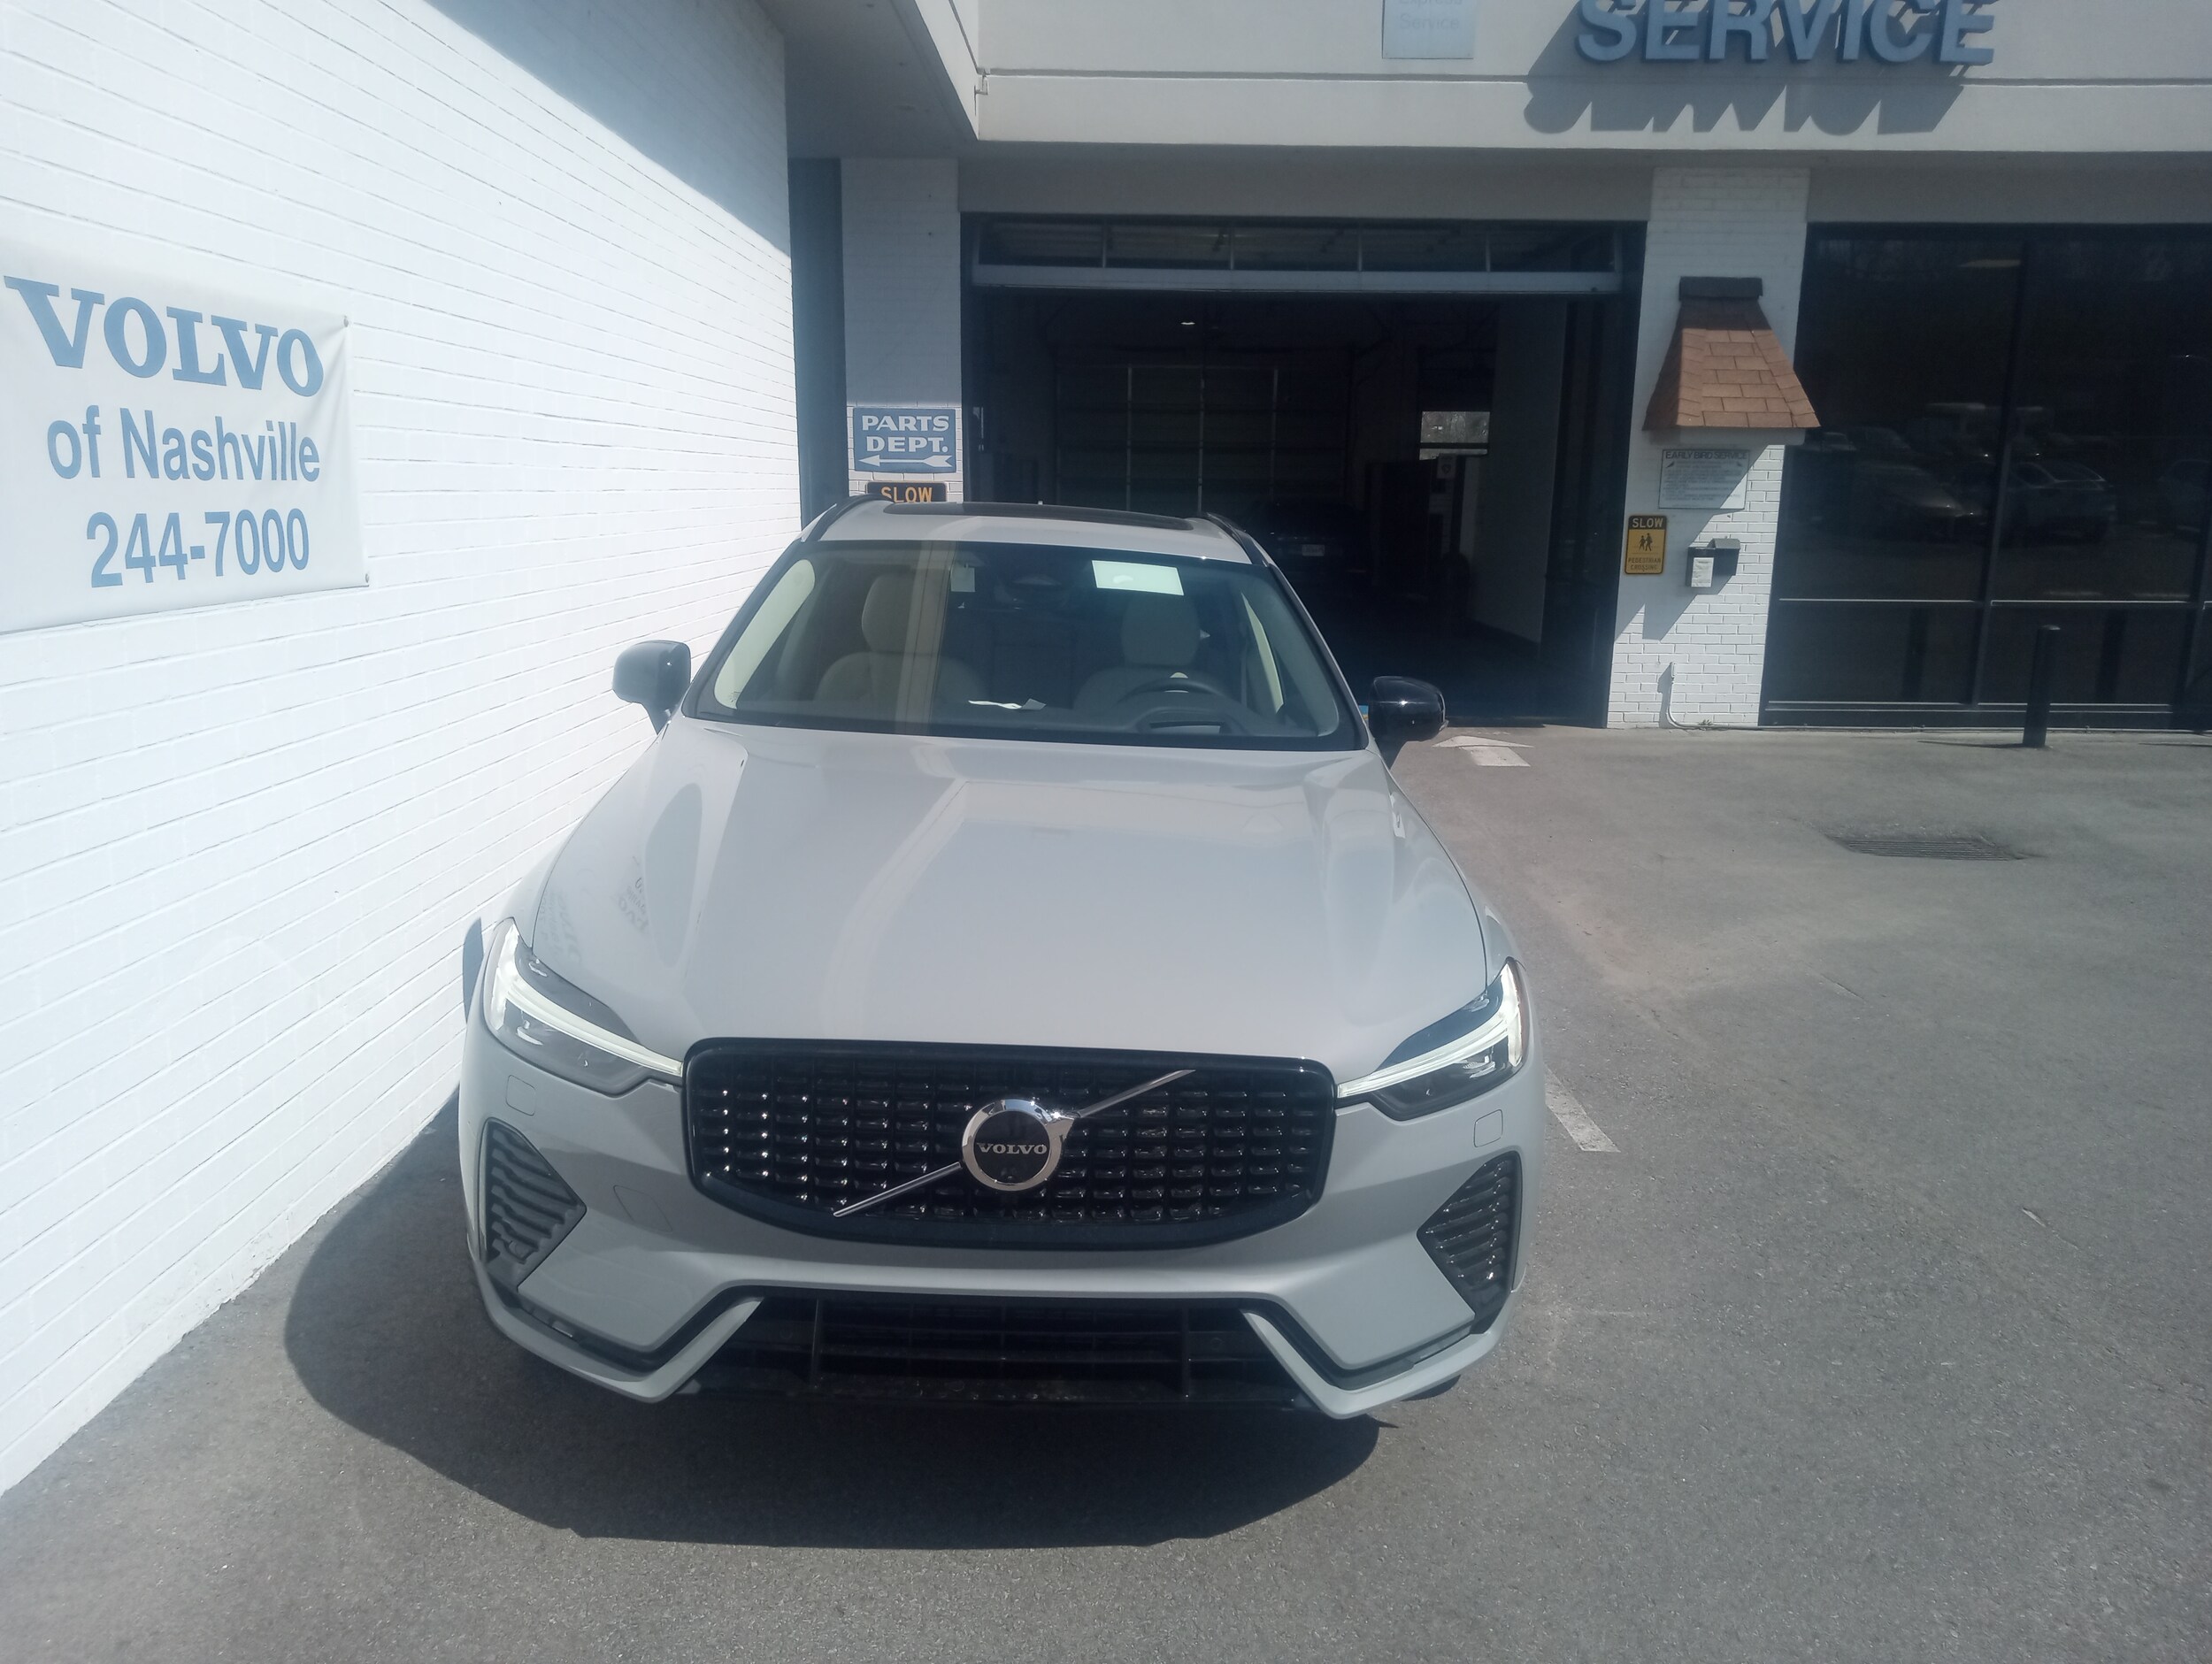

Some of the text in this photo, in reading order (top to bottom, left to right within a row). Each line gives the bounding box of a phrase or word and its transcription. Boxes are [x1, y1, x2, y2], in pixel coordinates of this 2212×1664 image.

[1400, 12, 1460, 30] Service
[1577, 0, 1995, 65] SERVICE
[4, 275, 324, 397] VOLVO
[862, 415, 949, 432] PARTS
[47, 404, 320, 482] of Nashville
[866, 436, 949, 453] DEPT.
[1665, 451, 1747, 460] EARLY BIRD SERVICE
[880, 486, 933, 503] SLOW
[1632, 518, 1663, 528] SLOW
[87, 507, 310, 588] 244-7000
[976, 1142, 1048, 1154] VOLVO
